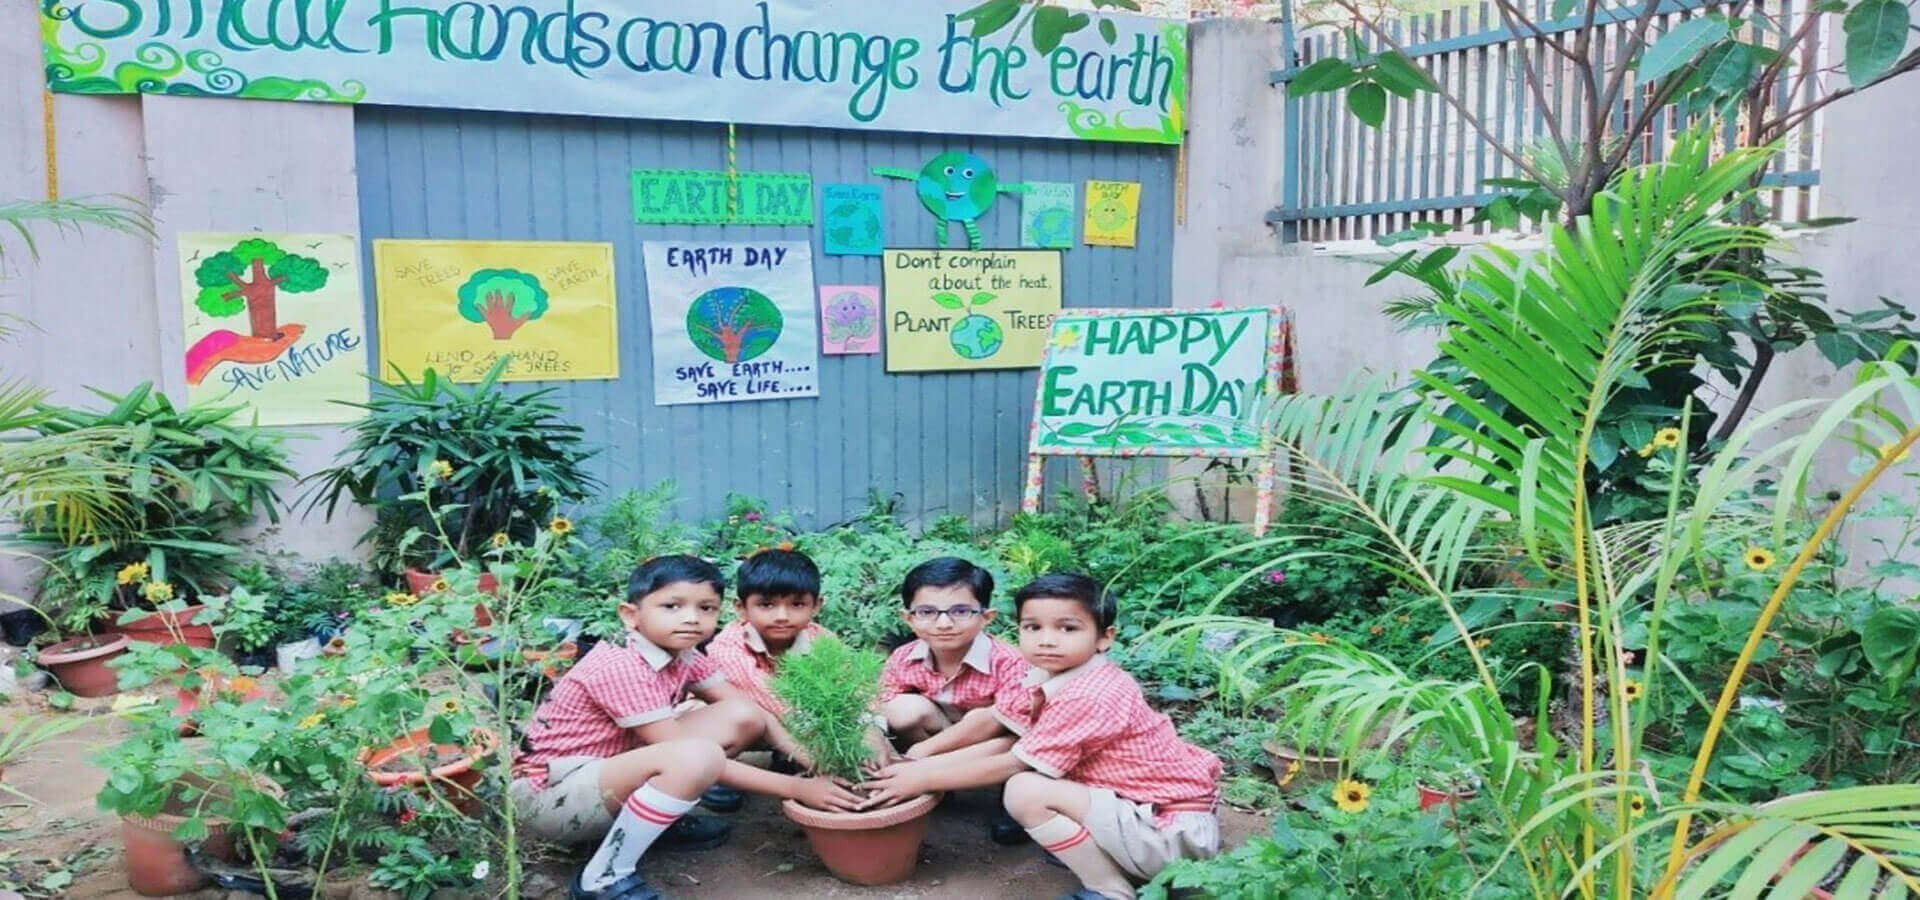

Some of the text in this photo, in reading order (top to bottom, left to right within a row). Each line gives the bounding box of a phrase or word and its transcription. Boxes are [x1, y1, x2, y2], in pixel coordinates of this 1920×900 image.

[367, 0, 611, 79] Hands
[616, 17, 727, 79] can
[735, 2, 919, 122] change
[938, 14, 1031, 107] the
[1050, 33, 1174, 112] earth
[640, 177, 809, 217] EARTH DAY
[395, 258, 433, 279] SAVE
[547, 259, 583, 282] SAVE
[667, 247, 787, 277] EARTH DAY
[948, 253, 1017, 274] complain
[419, 268, 462, 288] TREES
[559, 268, 603, 290] EARTH
[929, 274, 982, 291] about
[991, 275, 1013, 289] the
[894, 310, 952, 333] PLANT
[1085, 315, 1250, 366] HAPPY
[222, 328, 361, 393] SAVE NATURE
[425, 350, 474, 364] LEND
[508, 350, 560, 362] HAND
[472, 361, 515, 376] SAE
[526, 361, 573, 374] TREES
[676, 361, 715, 382] SAVE
[697, 380, 738, 400] SAVE
[1041, 365, 1172, 417] EARTH
